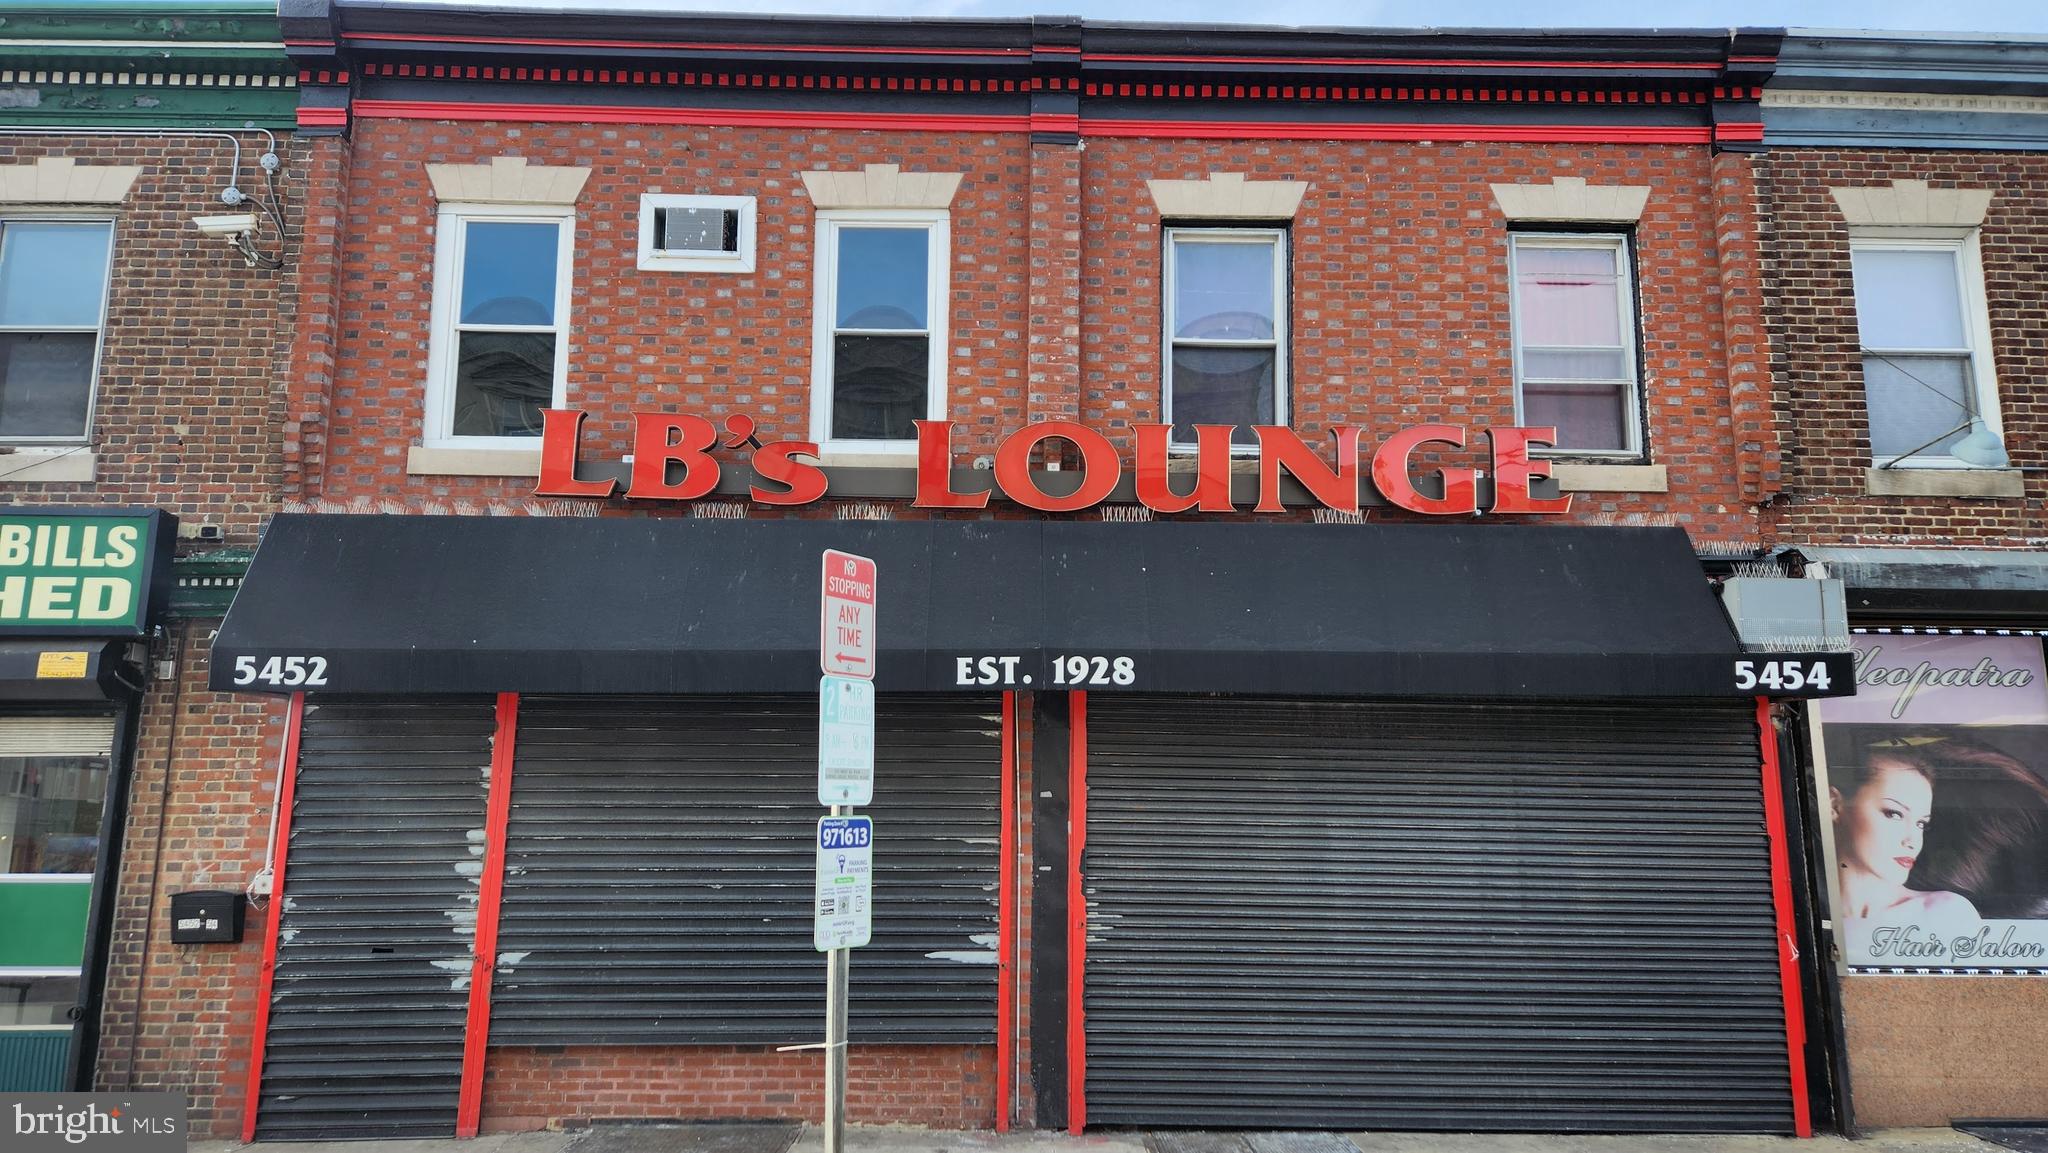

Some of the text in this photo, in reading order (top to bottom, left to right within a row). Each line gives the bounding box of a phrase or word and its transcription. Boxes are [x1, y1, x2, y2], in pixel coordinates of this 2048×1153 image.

[533, 408, 1574, 515] LB's LOUNGE
[0, 524, 139, 568] BILLS
[843, 559, 857, 577] NO
[828, 576, 871, 599] STOPPING
[839, 605, 861, 625] ANY
[837, 626, 862, 648] TIME
[233, 655, 328, 686] 5452
[956, 655, 1136, 685] EST. 1928
[1735, 661, 1831, 690] 5454
[1851, 645, 2034, 719] leopatra
[826, 685, 836, 718] 2
[839, 703, 871, 721] PARKING
[823, 827, 868, 847] 971613
[849, 859, 868, 867] PARKING
[1869, 925, 2044, 963] Hair Salon
